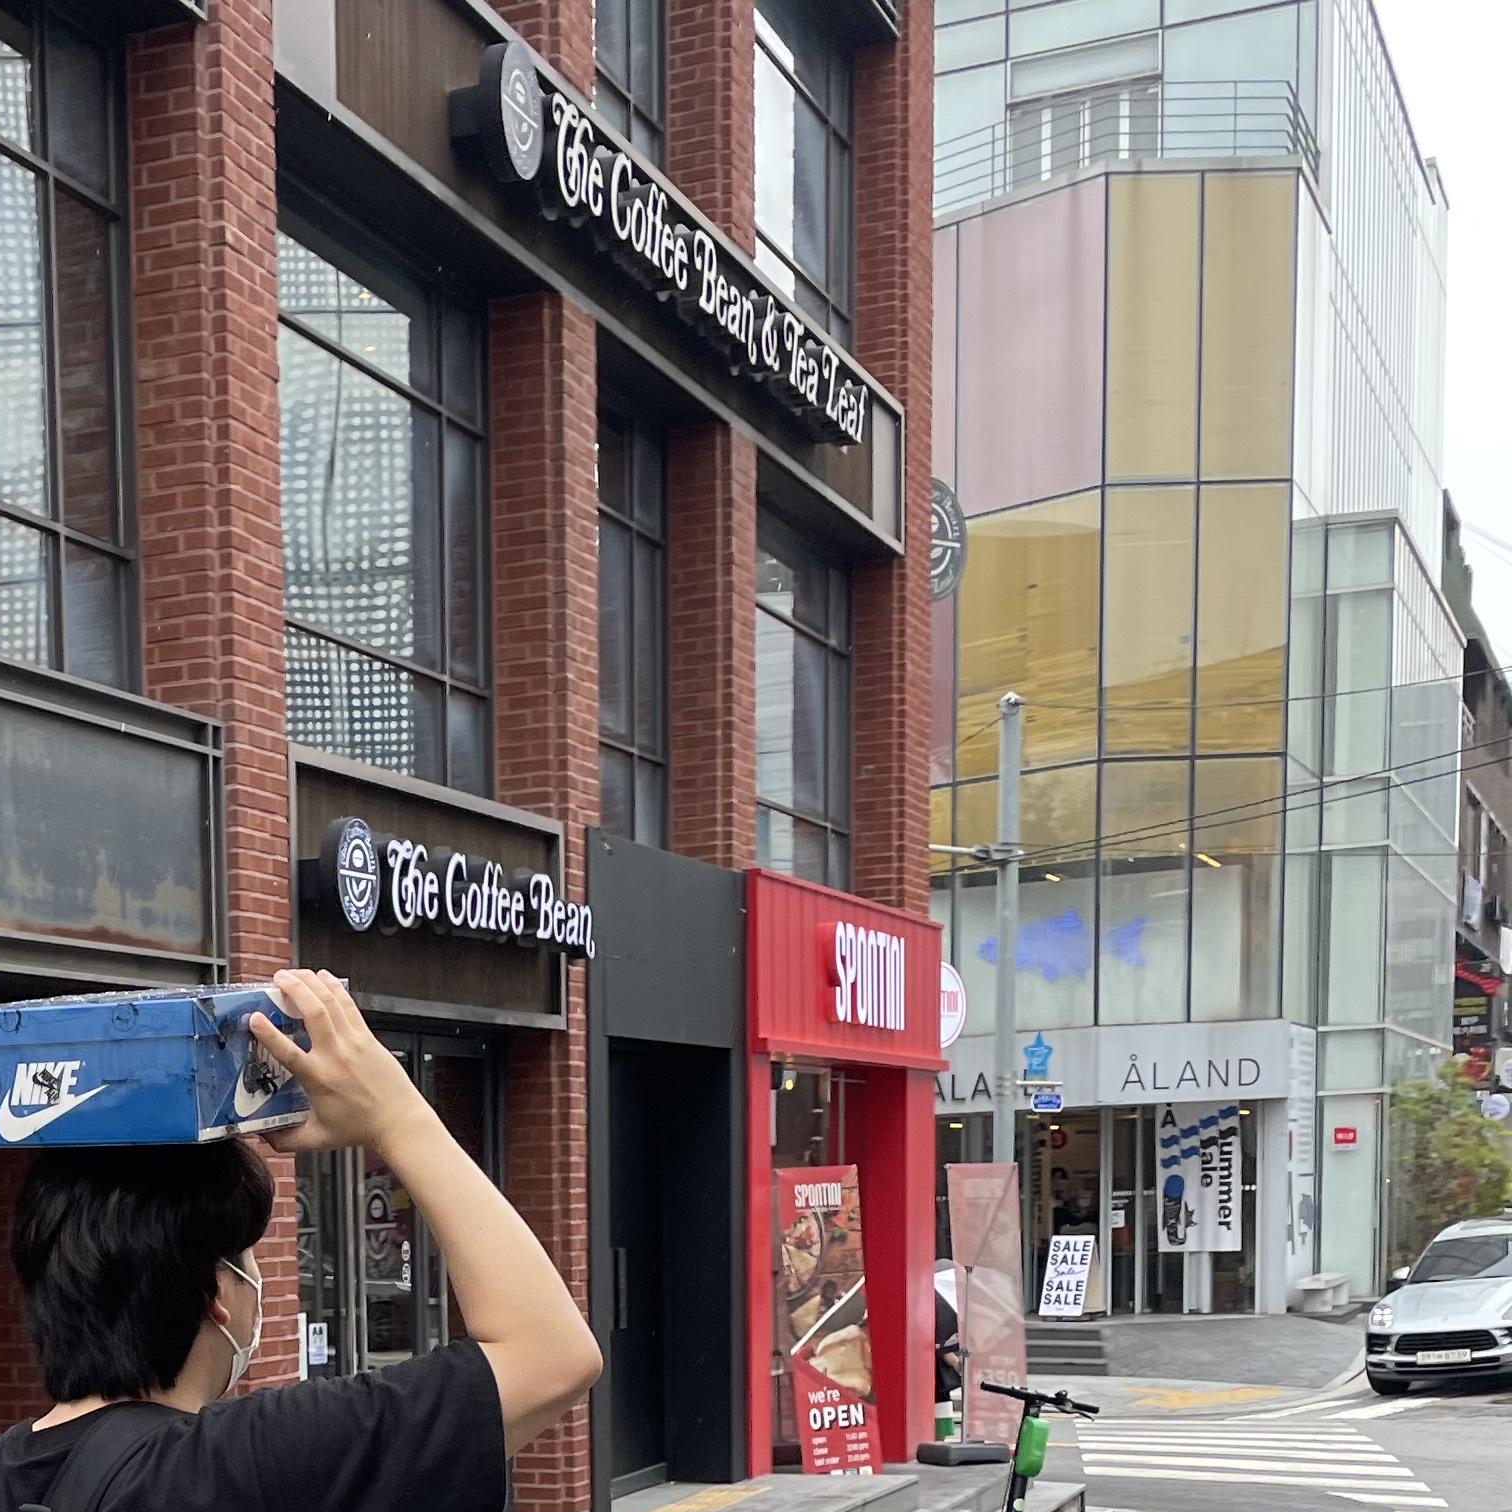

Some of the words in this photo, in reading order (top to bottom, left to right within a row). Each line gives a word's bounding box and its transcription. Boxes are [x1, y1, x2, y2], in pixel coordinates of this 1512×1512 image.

[552, 92, 604, 217] The
[611, 153, 690, 291] Coffee
[693, 229, 757, 365] Bean
[761, 296, 780, 373] &
[783, 312, 819, 407] Tea
[822, 345, 869, 444] Leaf
[387, 839, 439, 929] The
[445, 852, 525, 936] Coffee
[529, 873, 596, 960] Bean
[835, 920, 906, 1031] SPONTINI
[10, 1060, 81, 1106] NIKE
[1121, 1053, 1261, 1092] ÅLAND
[1049, 1253, 1089, 1266] SALE
[1052, 1240, 1092, 1252] SALE
[1043, 1293, 1082, 1306] SALE
[1045, 1280, 1084, 1292] SALE
[808, 1386, 841, 1405] we're
[809, 1402, 865, 1431] OPEN
